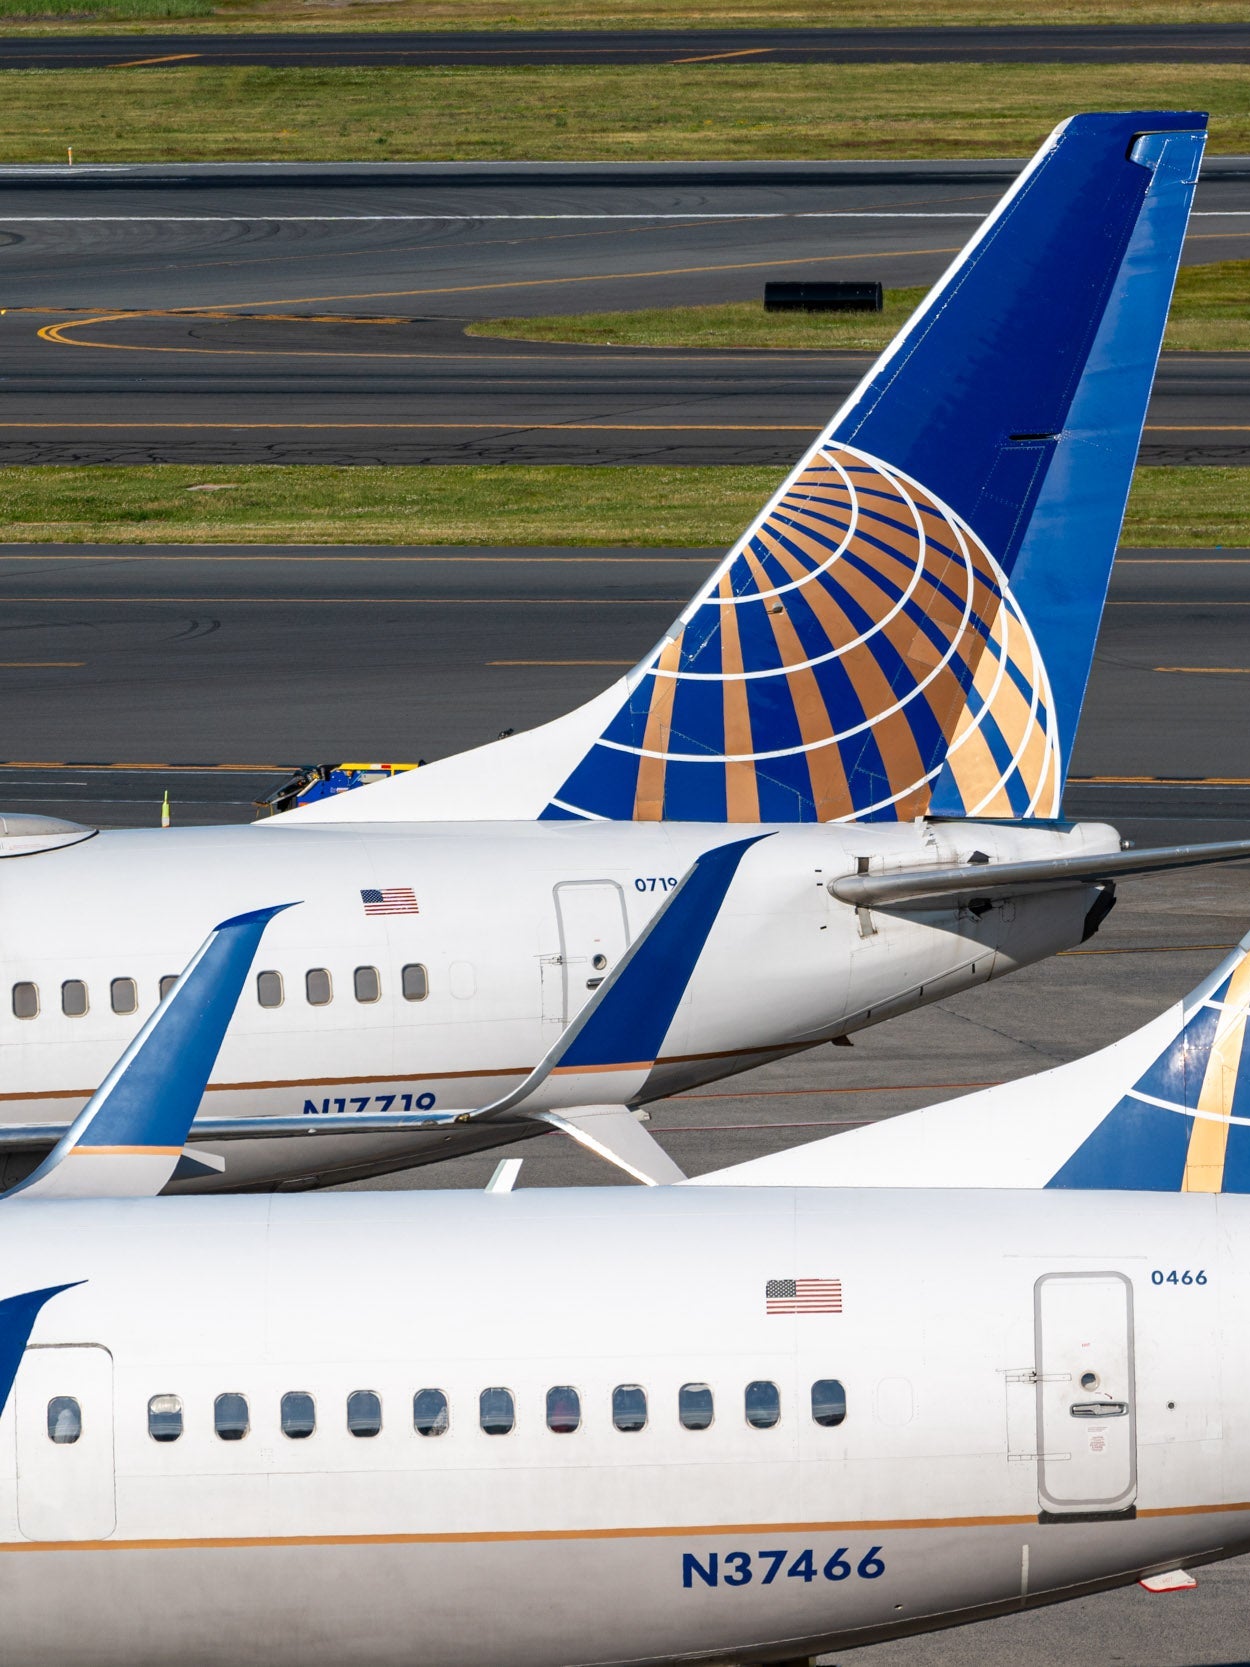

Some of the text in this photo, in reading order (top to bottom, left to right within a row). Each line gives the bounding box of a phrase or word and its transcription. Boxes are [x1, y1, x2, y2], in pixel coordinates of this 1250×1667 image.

[634, 877, 678, 892] 0719
[1151, 1269, 1208, 1286] 0466
[682, 1546, 886, 1588] N37466
